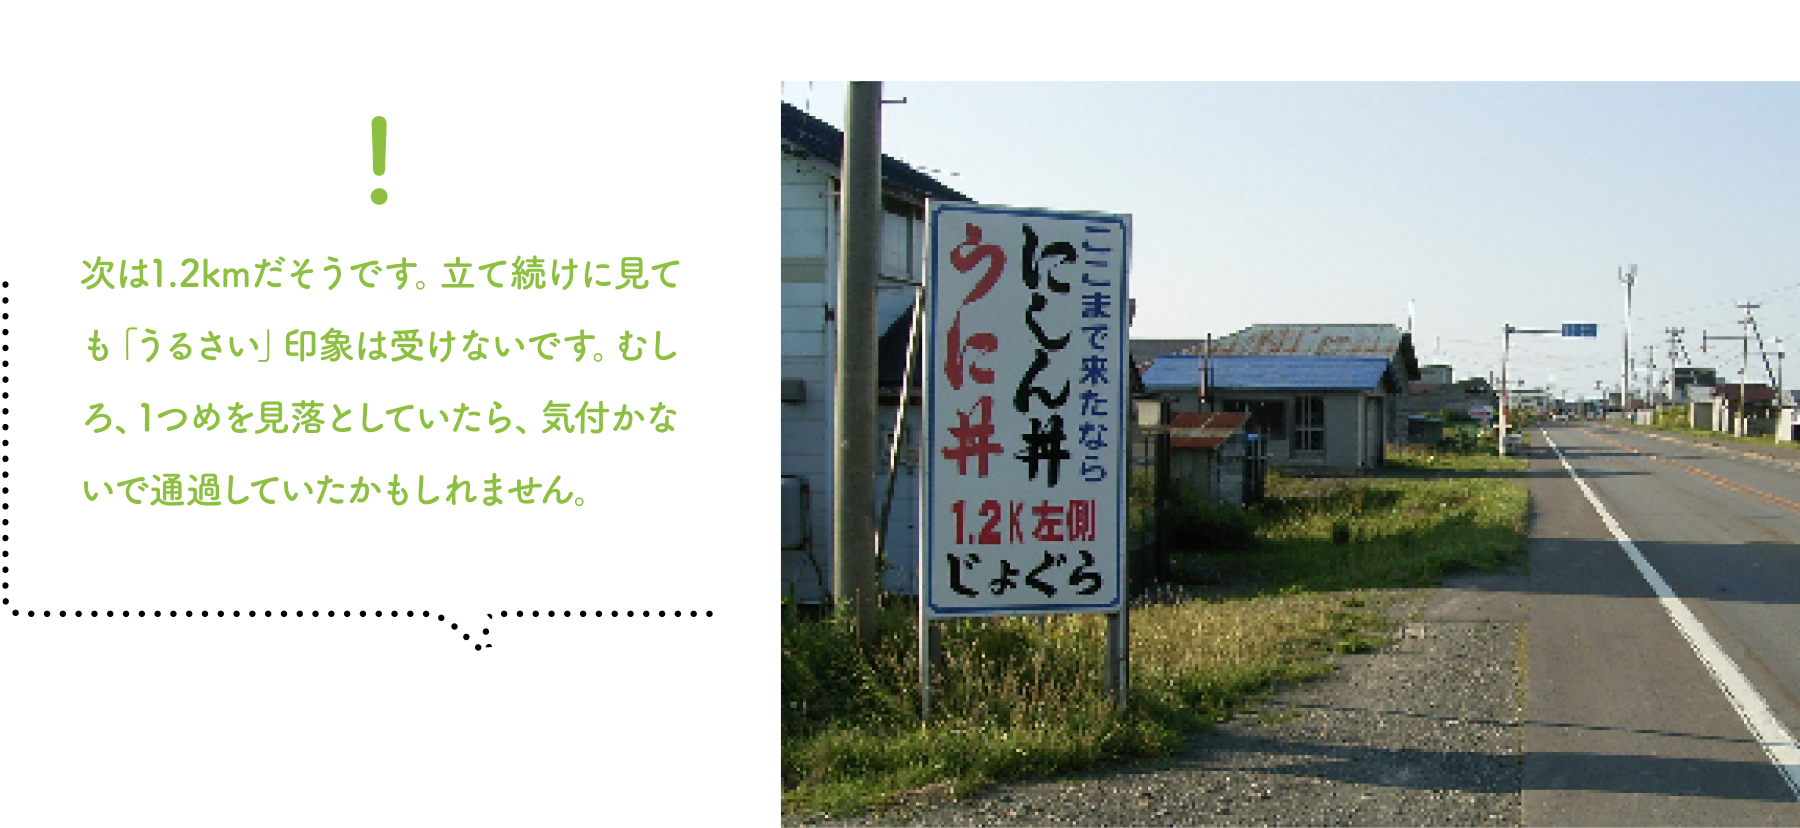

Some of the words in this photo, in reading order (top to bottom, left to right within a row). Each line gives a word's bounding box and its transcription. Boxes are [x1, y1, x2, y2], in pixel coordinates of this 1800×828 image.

[941, 223, 1006, 478] うに丼
[1013, 223, 1078, 487] にしん丼
[1078, 225, 1112, 483] ここまで来たなら
[947, 550, 1103, 598] じょぐら
